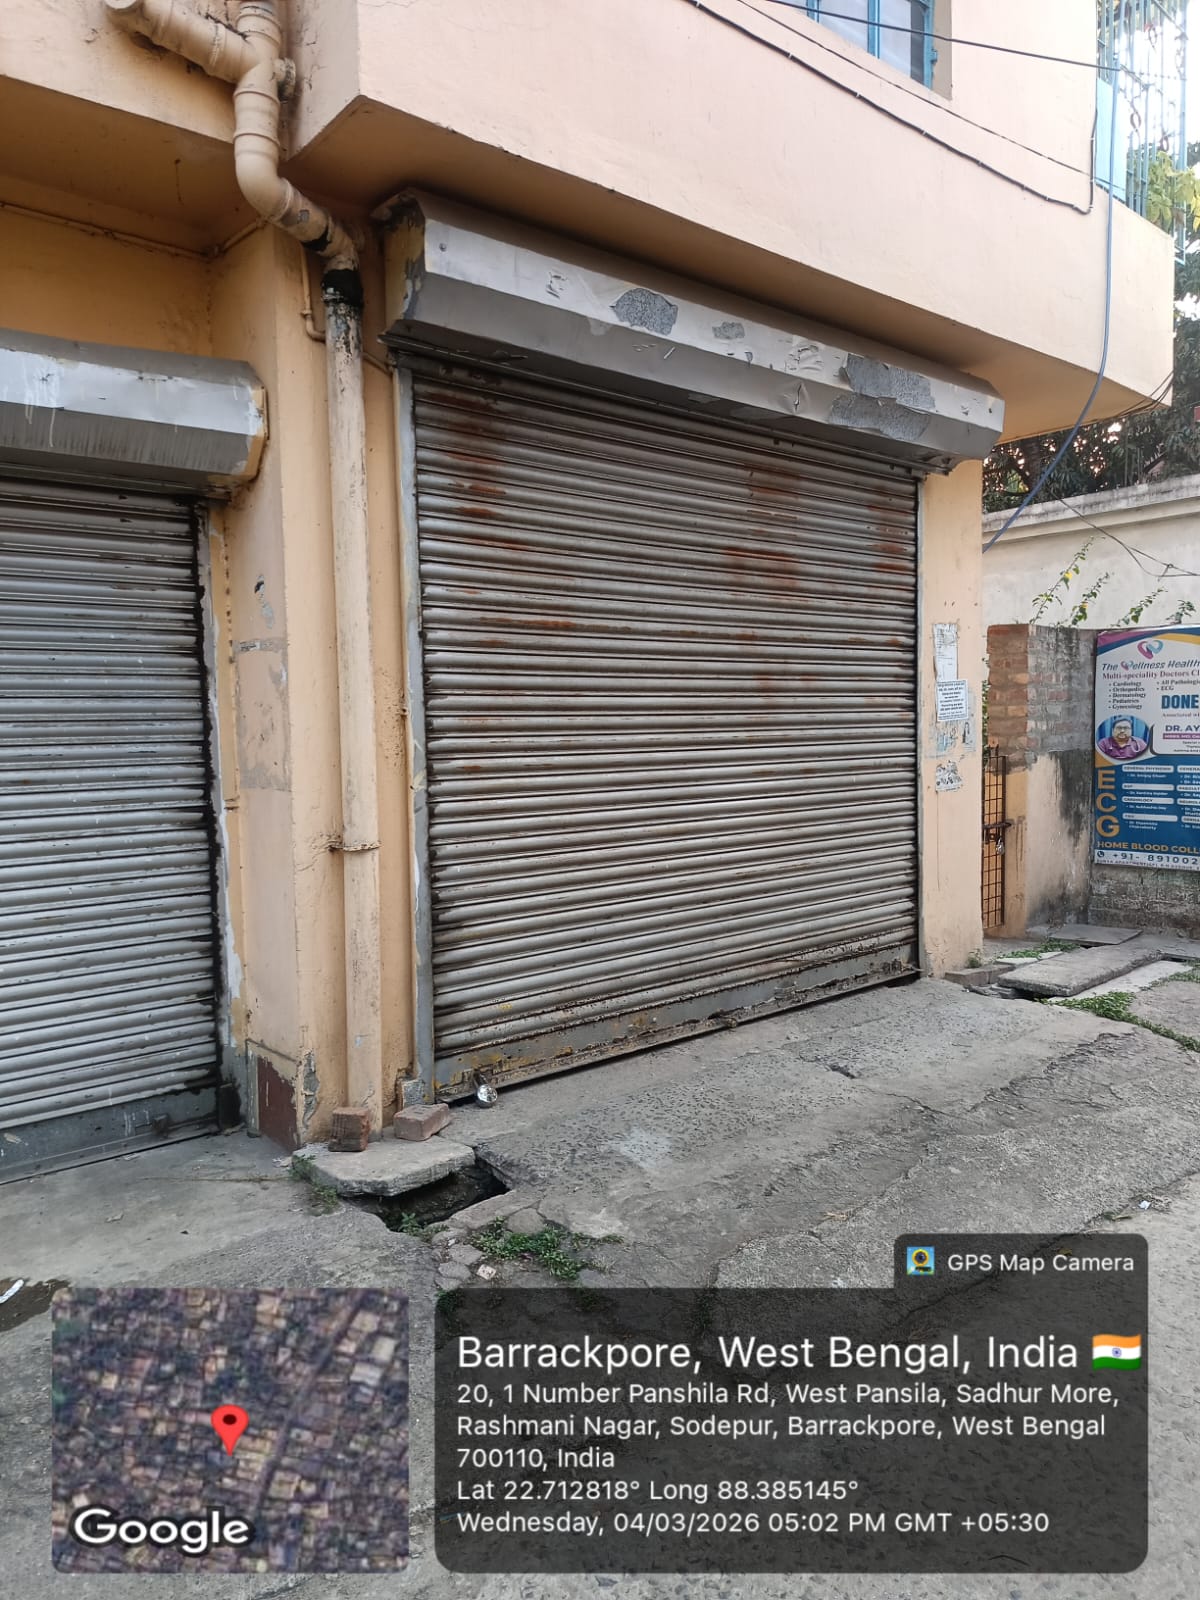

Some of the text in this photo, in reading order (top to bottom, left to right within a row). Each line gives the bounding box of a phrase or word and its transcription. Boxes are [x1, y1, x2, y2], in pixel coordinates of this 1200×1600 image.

[1102, 663, 1118, 671] The
[1102, 671, 1158, 681] Multi-speciality
[1159, 670, 1189, 678] Doctors
[1161, 694, 1200, 709] DONE
[1165, 724, 1183, 732] DR.
[1097, 841, 1129, 849] HOME
[1131, 842, 1169, 852] BLOOD
